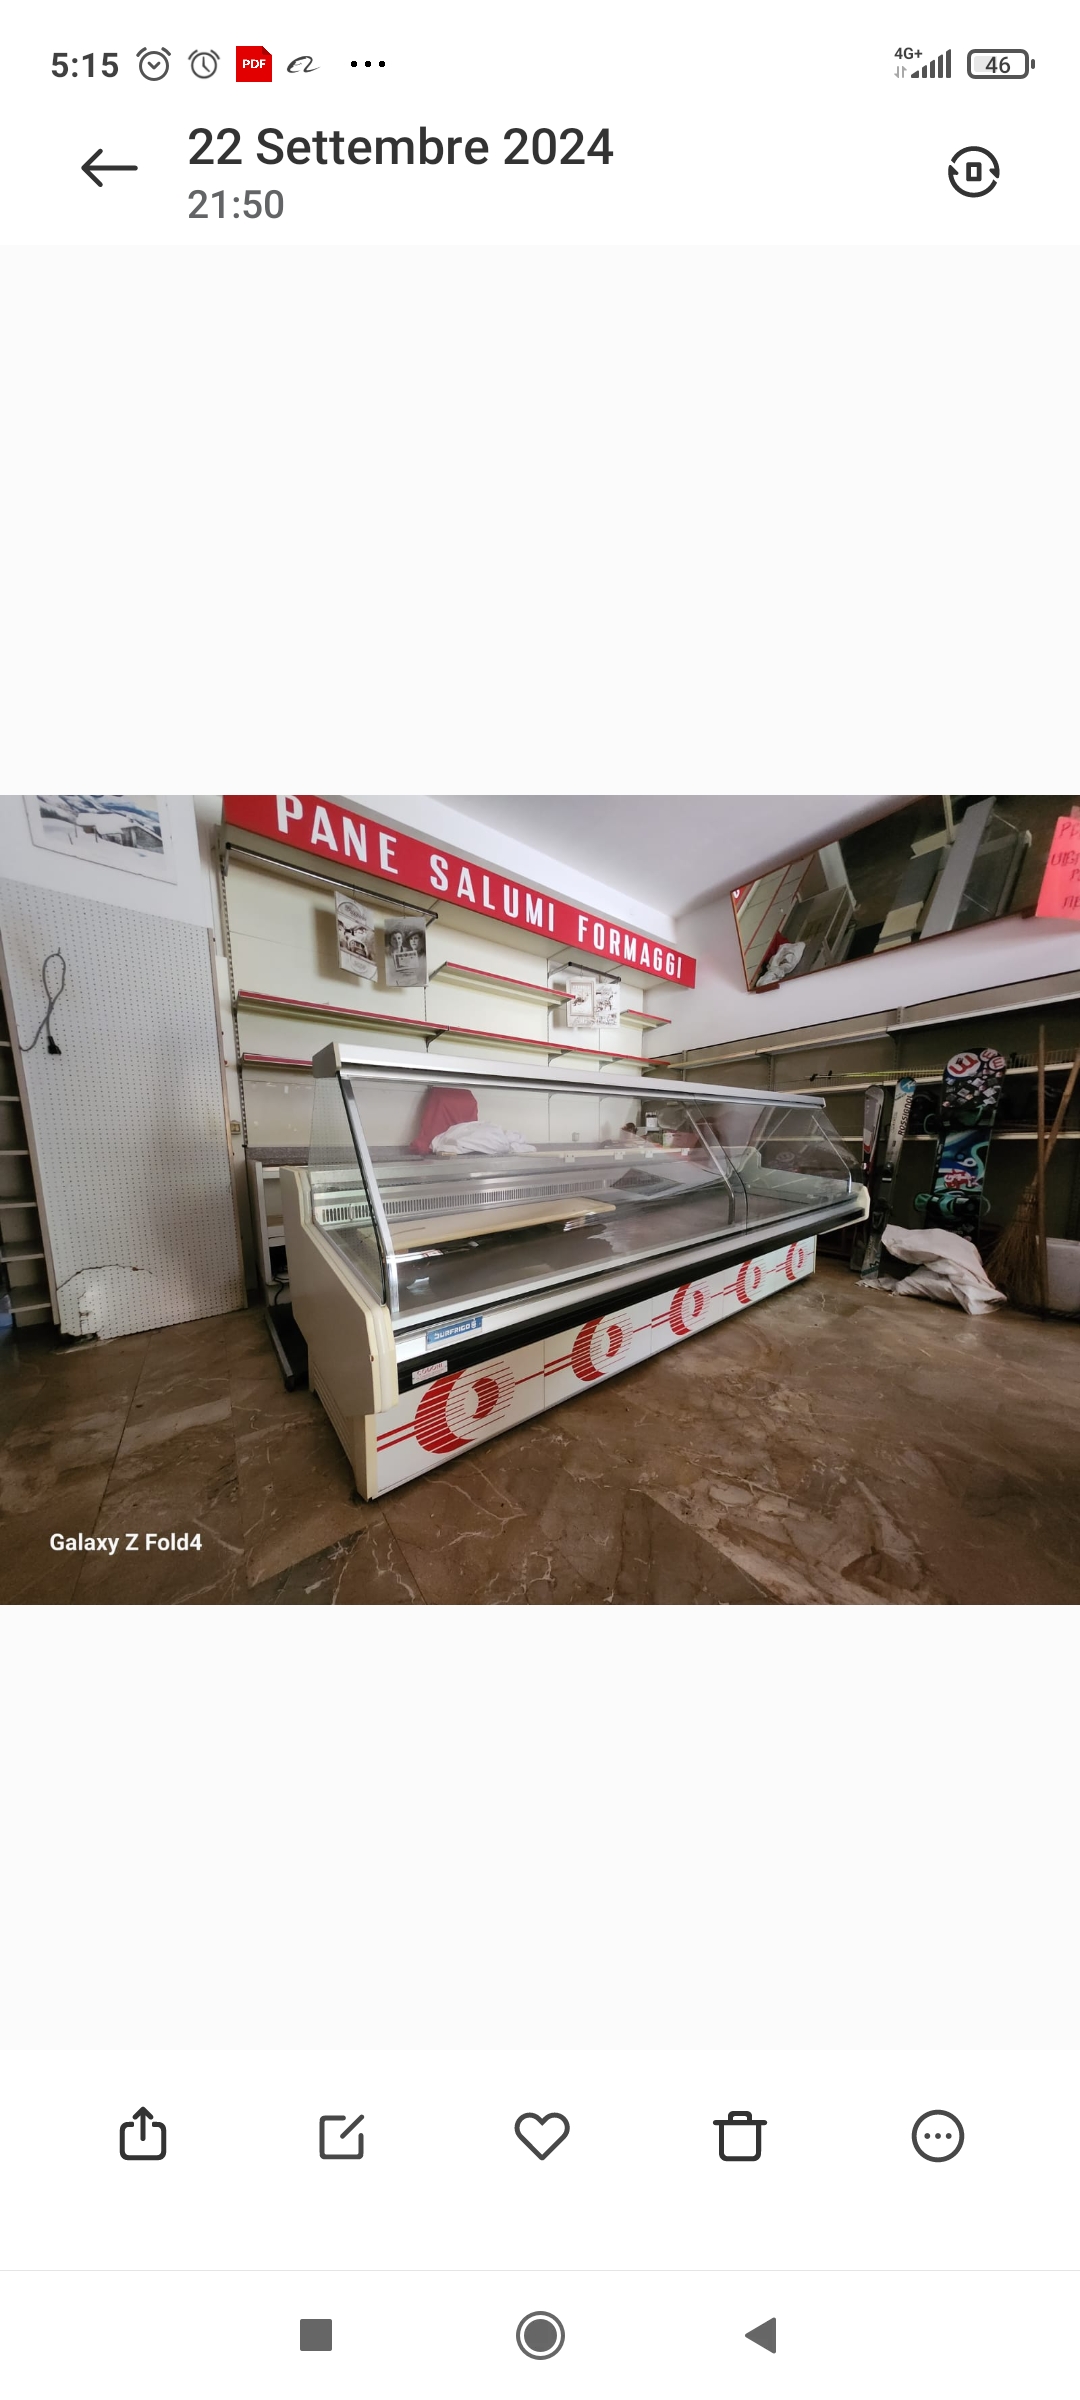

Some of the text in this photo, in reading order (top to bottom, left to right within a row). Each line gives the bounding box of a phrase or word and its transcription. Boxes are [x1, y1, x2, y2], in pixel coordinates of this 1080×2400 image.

[51, 52, 119, 78] 5:15
[242, 59, 266, 69] PDF
[894, 47, 923, 60] 4G+
[985, 56, 1011, 74] 46
[188, 126, 614, 165] 22 Settembre 2024
[188, 189, 284, 219] 21:50
[276, 795, 683, 979] PANE SALUMI FORMAGGI
